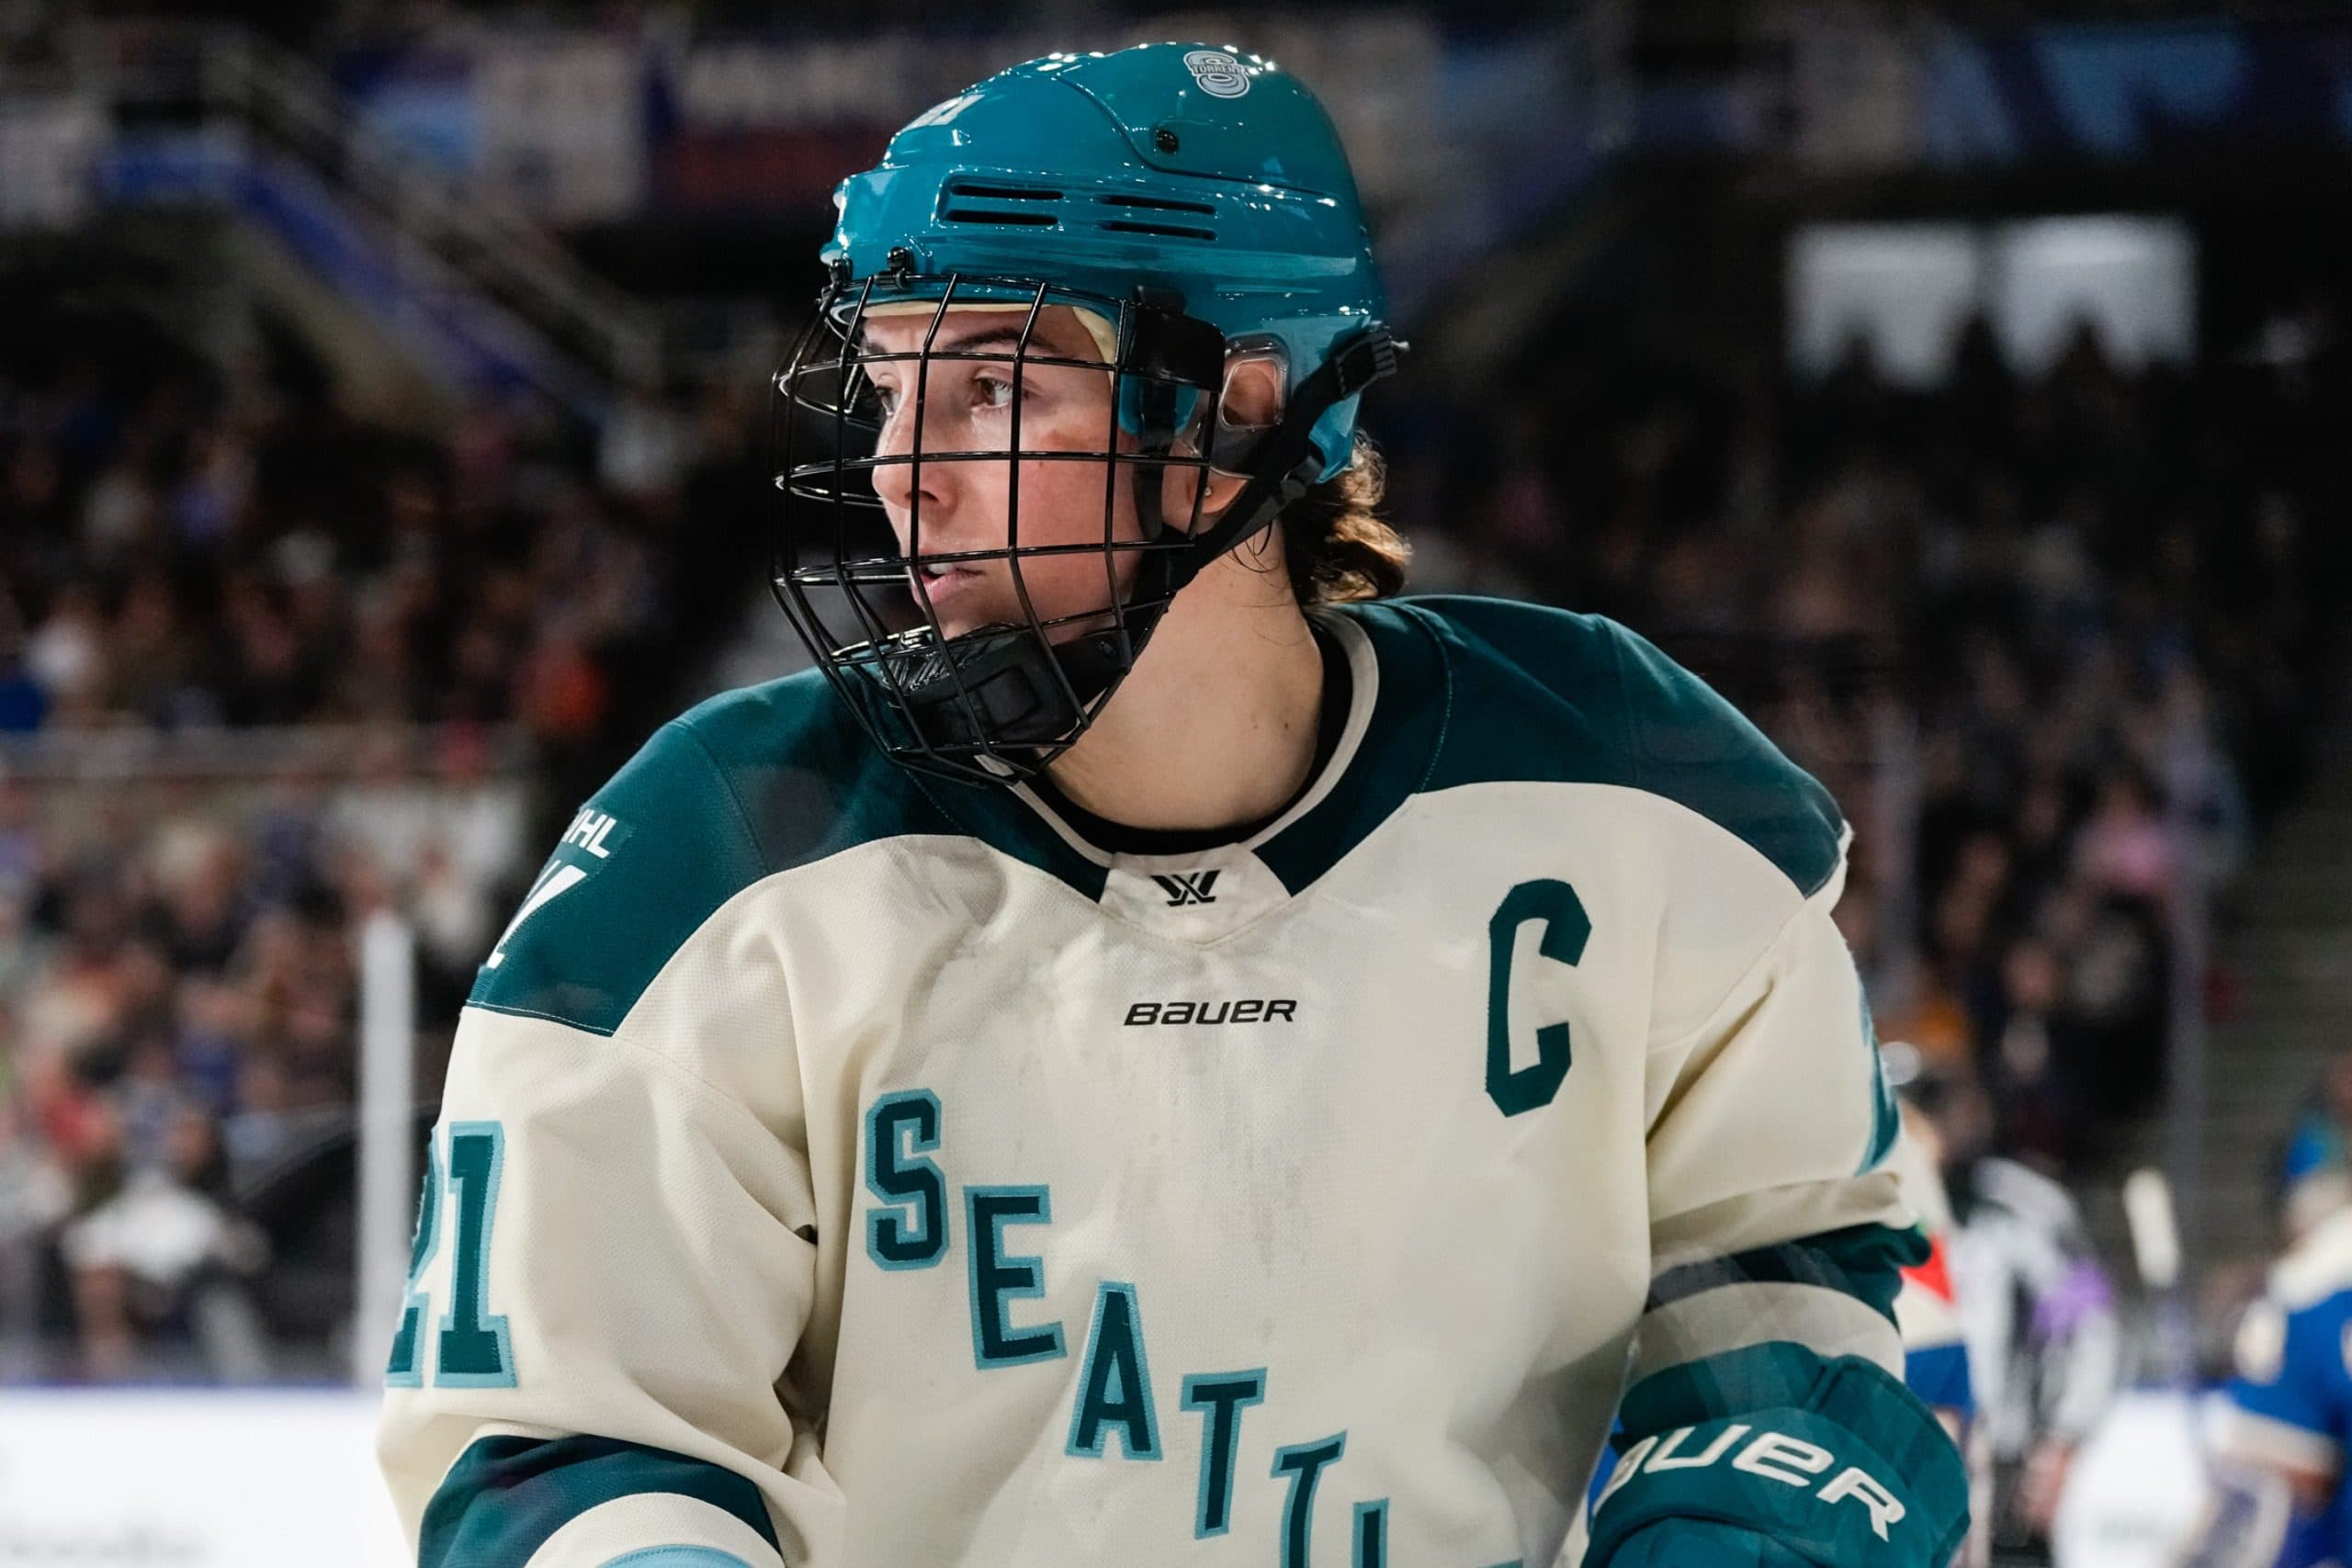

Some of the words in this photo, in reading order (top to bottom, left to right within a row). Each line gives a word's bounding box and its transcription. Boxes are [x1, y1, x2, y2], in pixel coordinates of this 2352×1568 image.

[1193, 64, 1241, 74] TORRENT
[561, 808, 617, 859] HL
[1485, 878, 1592, 1118] C
[865, 1088, 1522, 1568] SEATT
